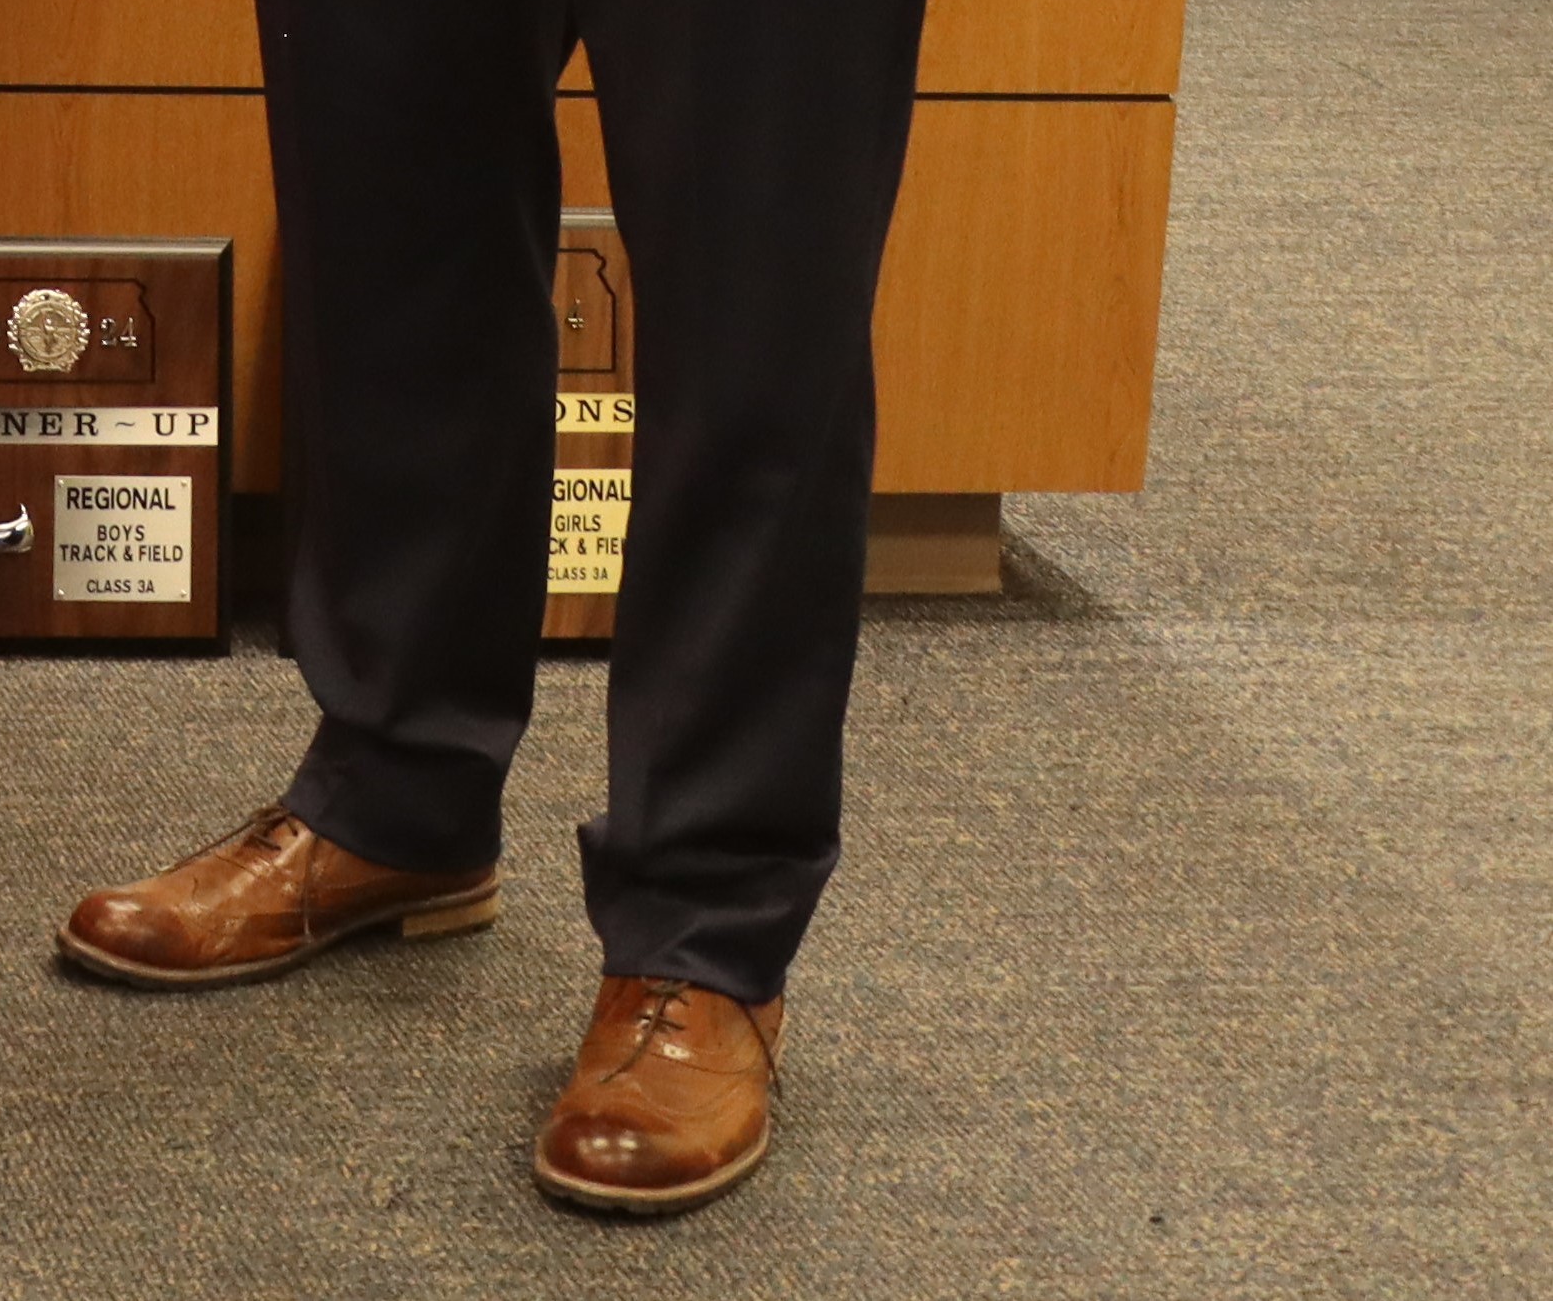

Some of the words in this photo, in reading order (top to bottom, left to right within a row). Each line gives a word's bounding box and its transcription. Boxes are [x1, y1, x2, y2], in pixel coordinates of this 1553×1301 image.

[152, 412, 210, 437] UP
[66, 487, 177, 511] REGIONAL
[554, 514, 602, 532] GIRLS
[97, 524, 146, 542] BOYS
[59, 544, 118, 562] TRACK
[122, 545, 134, 562] &
[138, 545, 184, 563] FIELD
[577, 537, 588, 555] &
[596, 537, 626, 556] FIE
[592, 566, 609, 581] 3A
[86, 579, 131, 594] CLASS
[137, 579, 155, 594] 3A
